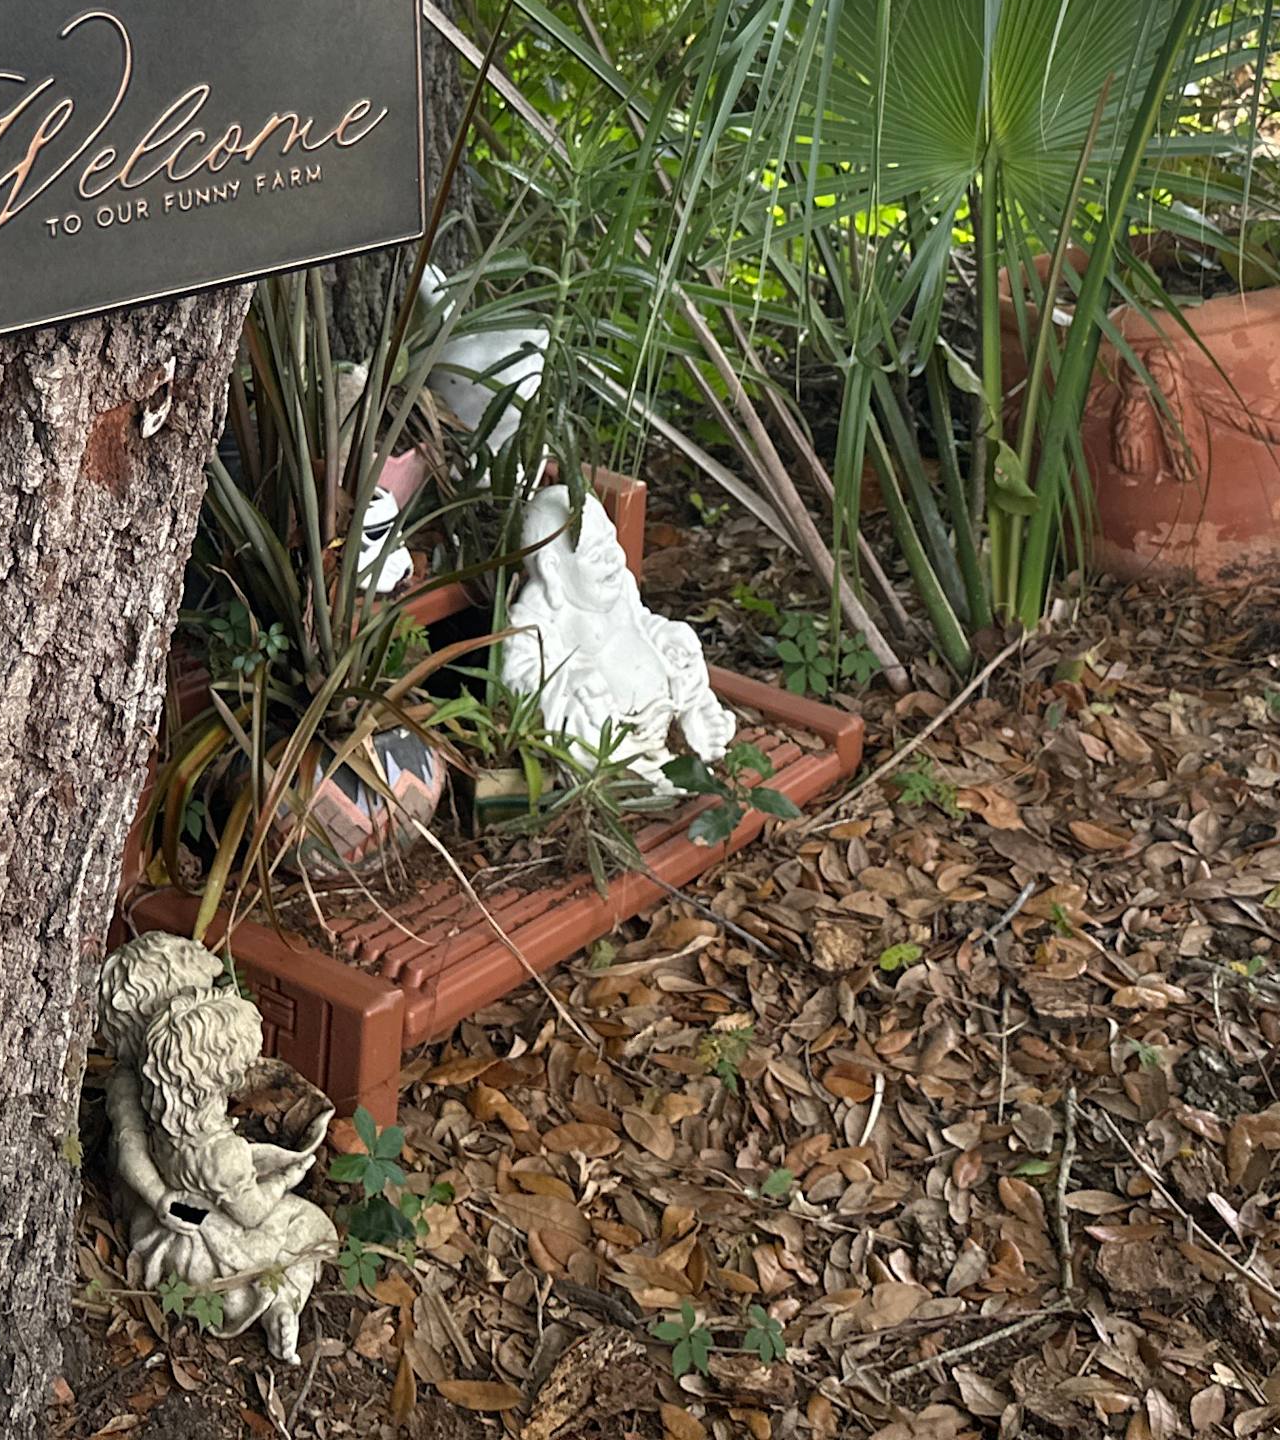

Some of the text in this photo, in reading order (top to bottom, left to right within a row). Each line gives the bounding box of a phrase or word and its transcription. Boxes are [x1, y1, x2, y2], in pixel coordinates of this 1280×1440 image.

[46, 164, 324, 237] TO OUR FUNNY FARM
